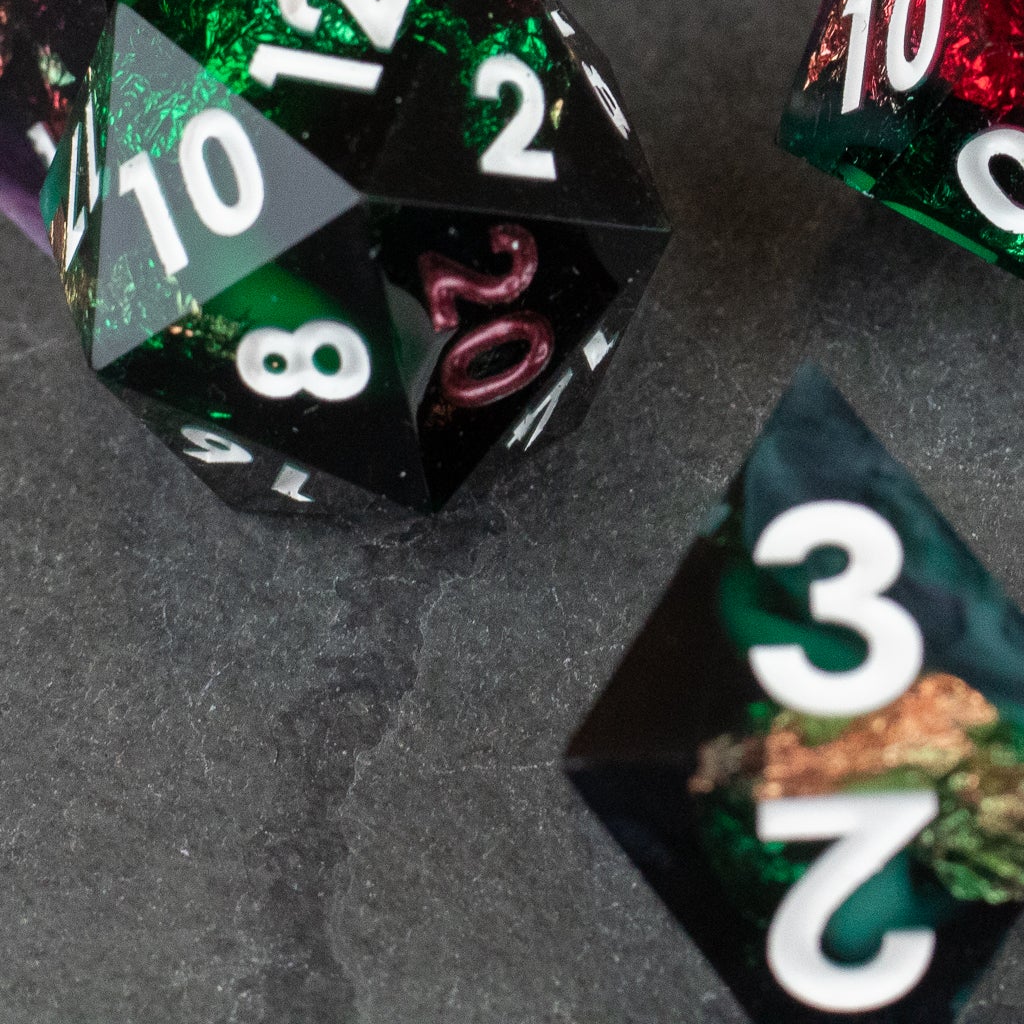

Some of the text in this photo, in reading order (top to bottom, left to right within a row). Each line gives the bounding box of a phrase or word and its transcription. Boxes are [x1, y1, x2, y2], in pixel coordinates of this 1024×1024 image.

[119, 108, 265, 277] 10
[473, 53, 557, 181] 2
[235, 319, 372, 402] 8
[417, 223, 555, 407] 20
[749, 499, 925, 718] 3
[755, 788, 940, 1015] 2
